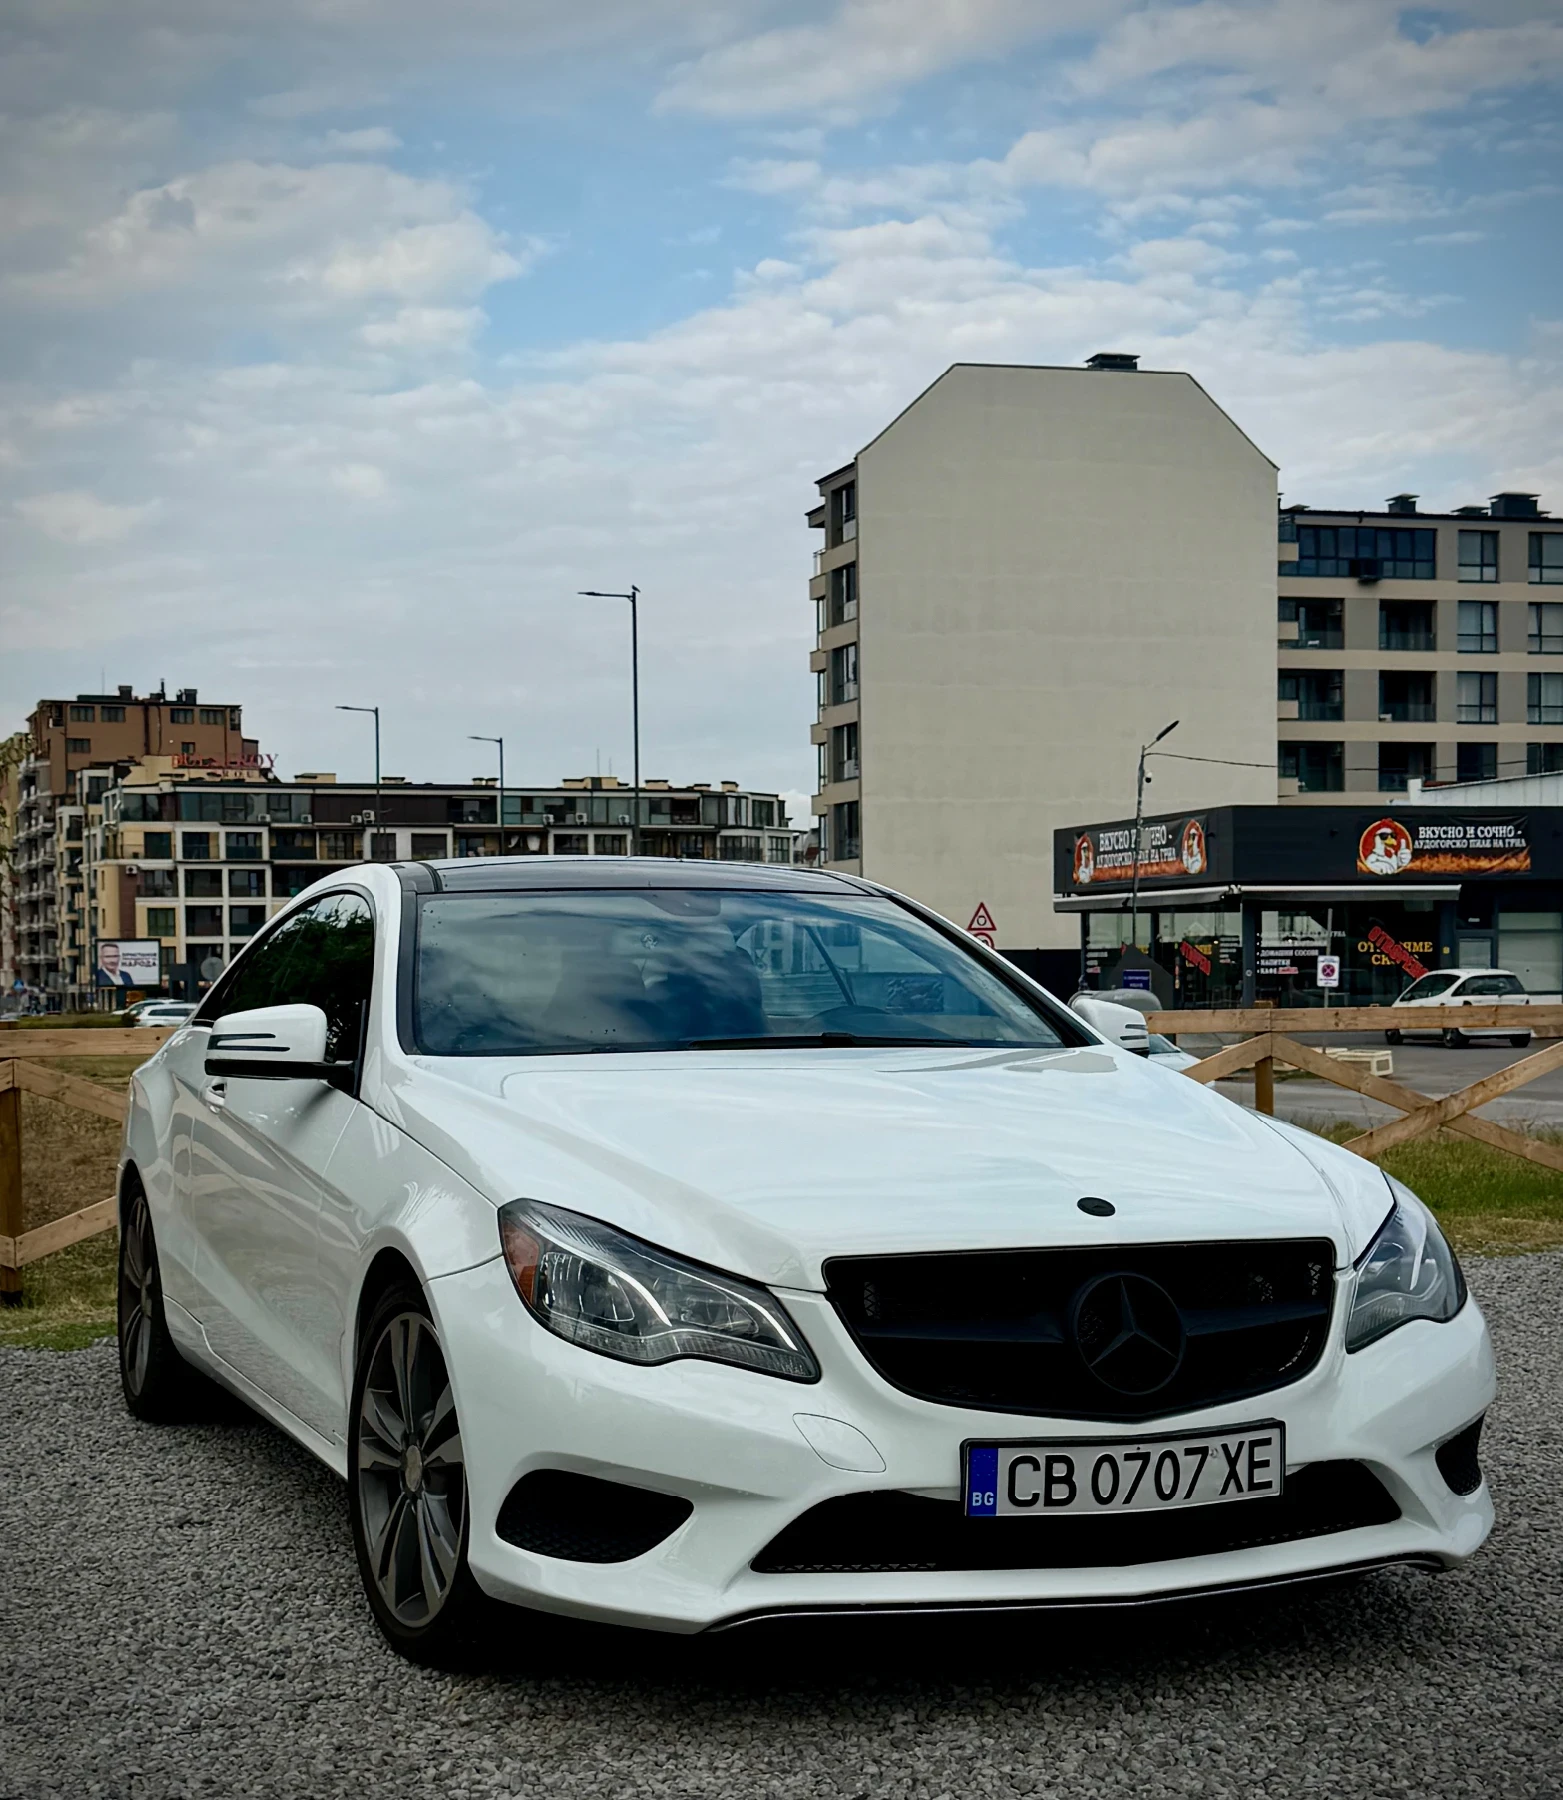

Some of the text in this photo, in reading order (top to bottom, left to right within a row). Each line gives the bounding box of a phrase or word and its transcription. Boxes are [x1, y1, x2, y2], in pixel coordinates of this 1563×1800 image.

[1418, 826, 1464, 839] ВКУСНО
[1477, 825, 1514, 838] СОЧНО
[1492, 839, 1504, 848] НА
[1007, 1436, 1273, 1507] CB 0707 XE
[972, 1491, 994, 1507] BG
